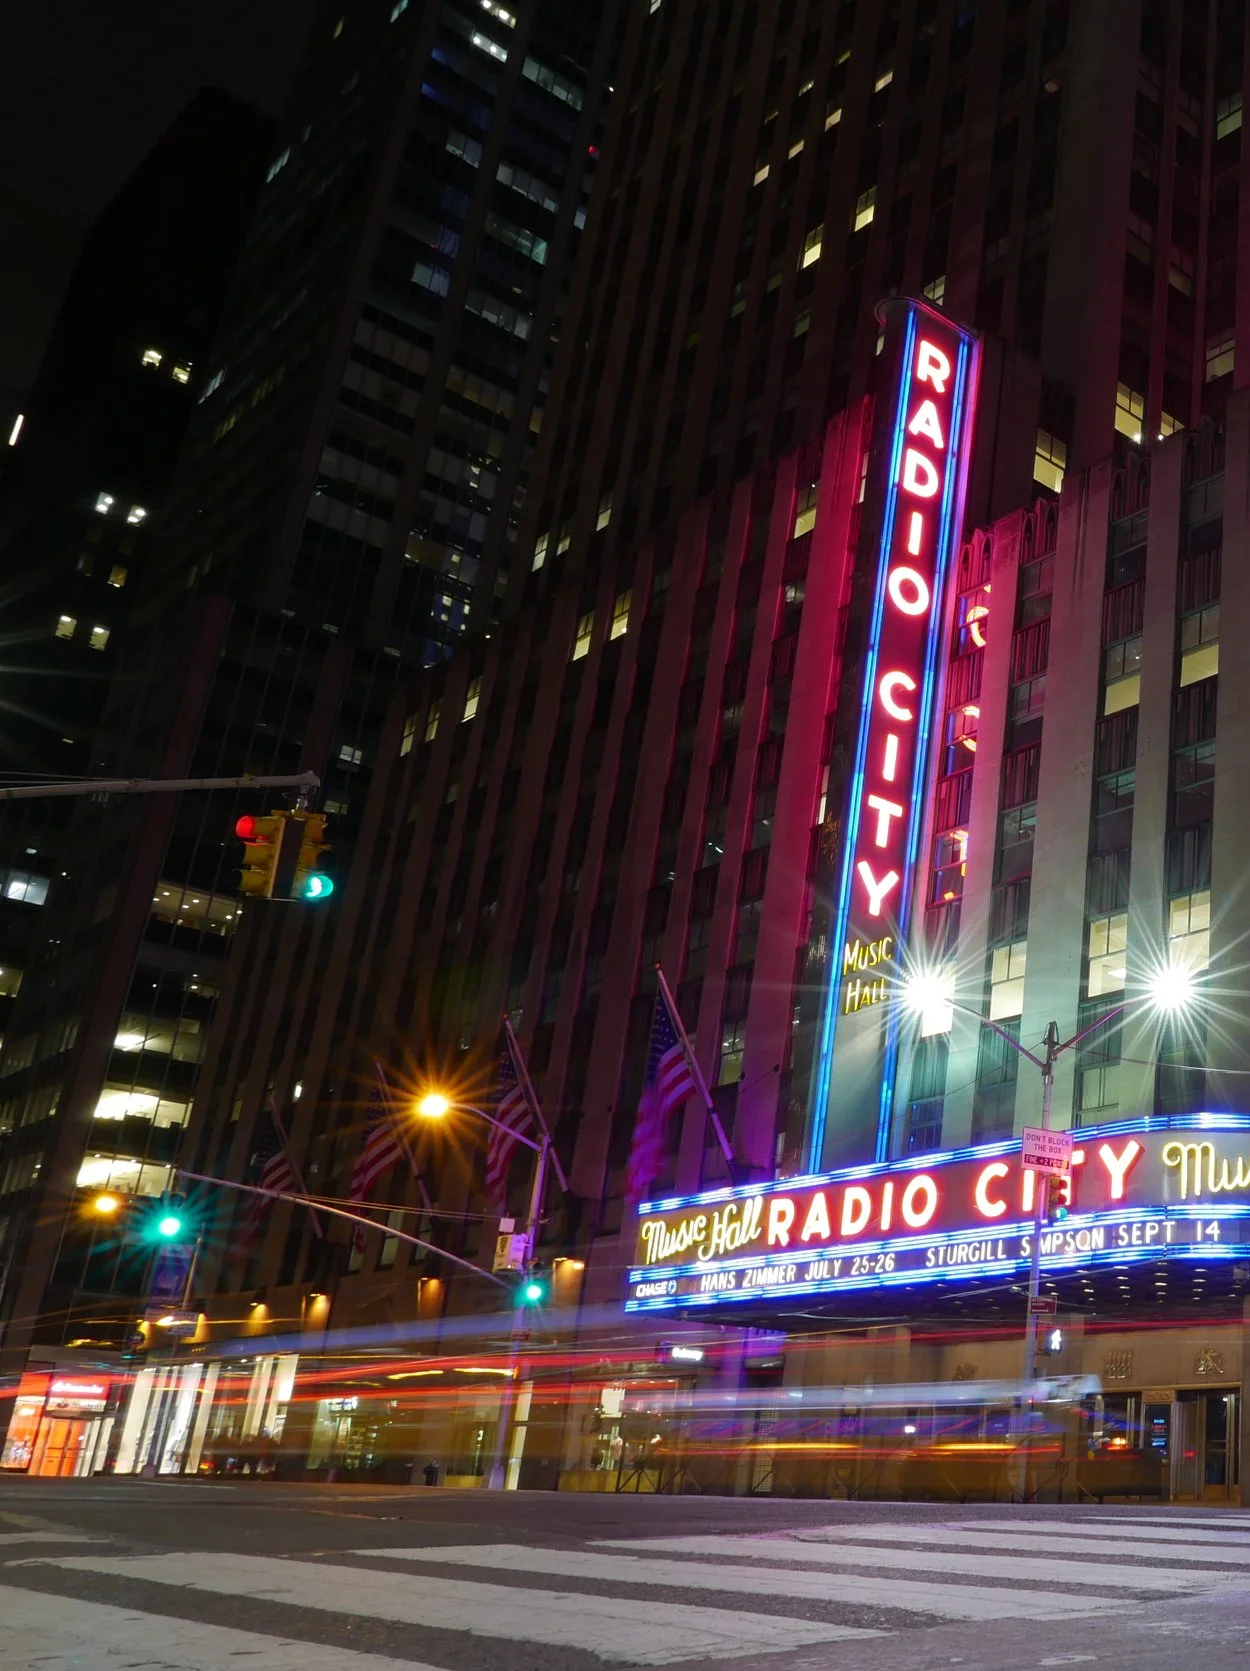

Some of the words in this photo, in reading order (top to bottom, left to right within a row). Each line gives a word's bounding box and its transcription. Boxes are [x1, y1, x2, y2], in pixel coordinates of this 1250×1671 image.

[888, 339, 951, 616] RADIO
[857, 671, 916, 917] CITY
[1026, 1133, 1046, 1143] DON'T
[1048, 1137, 1070, 1146] BLOCK
[1034, 1143, 1047, 1152] THE
[1049, 1146, 1062, 1154] BOX
[642, 1215, 707, 1264] Music
[698, 1195, 763, 1261] Hall
[768, 1175, 937, 1247] RADIO
[926, 1239, 1007, 1268] STURGILL
[1021, 1226, 1104, 1257] SMPSON
[1118, 1221, 1175, 1246] SEPT
[1197, 1220, 1221, 1242] 14
[636, 1281, 667, 1298] CHASE
[701, 1271, 736, 1292] HANS
[742, 1265, 797, 1288] ZIMMER
[804, 1259, 842, 1281] JULY
[851, 1253, 896, 1275] 25-26
